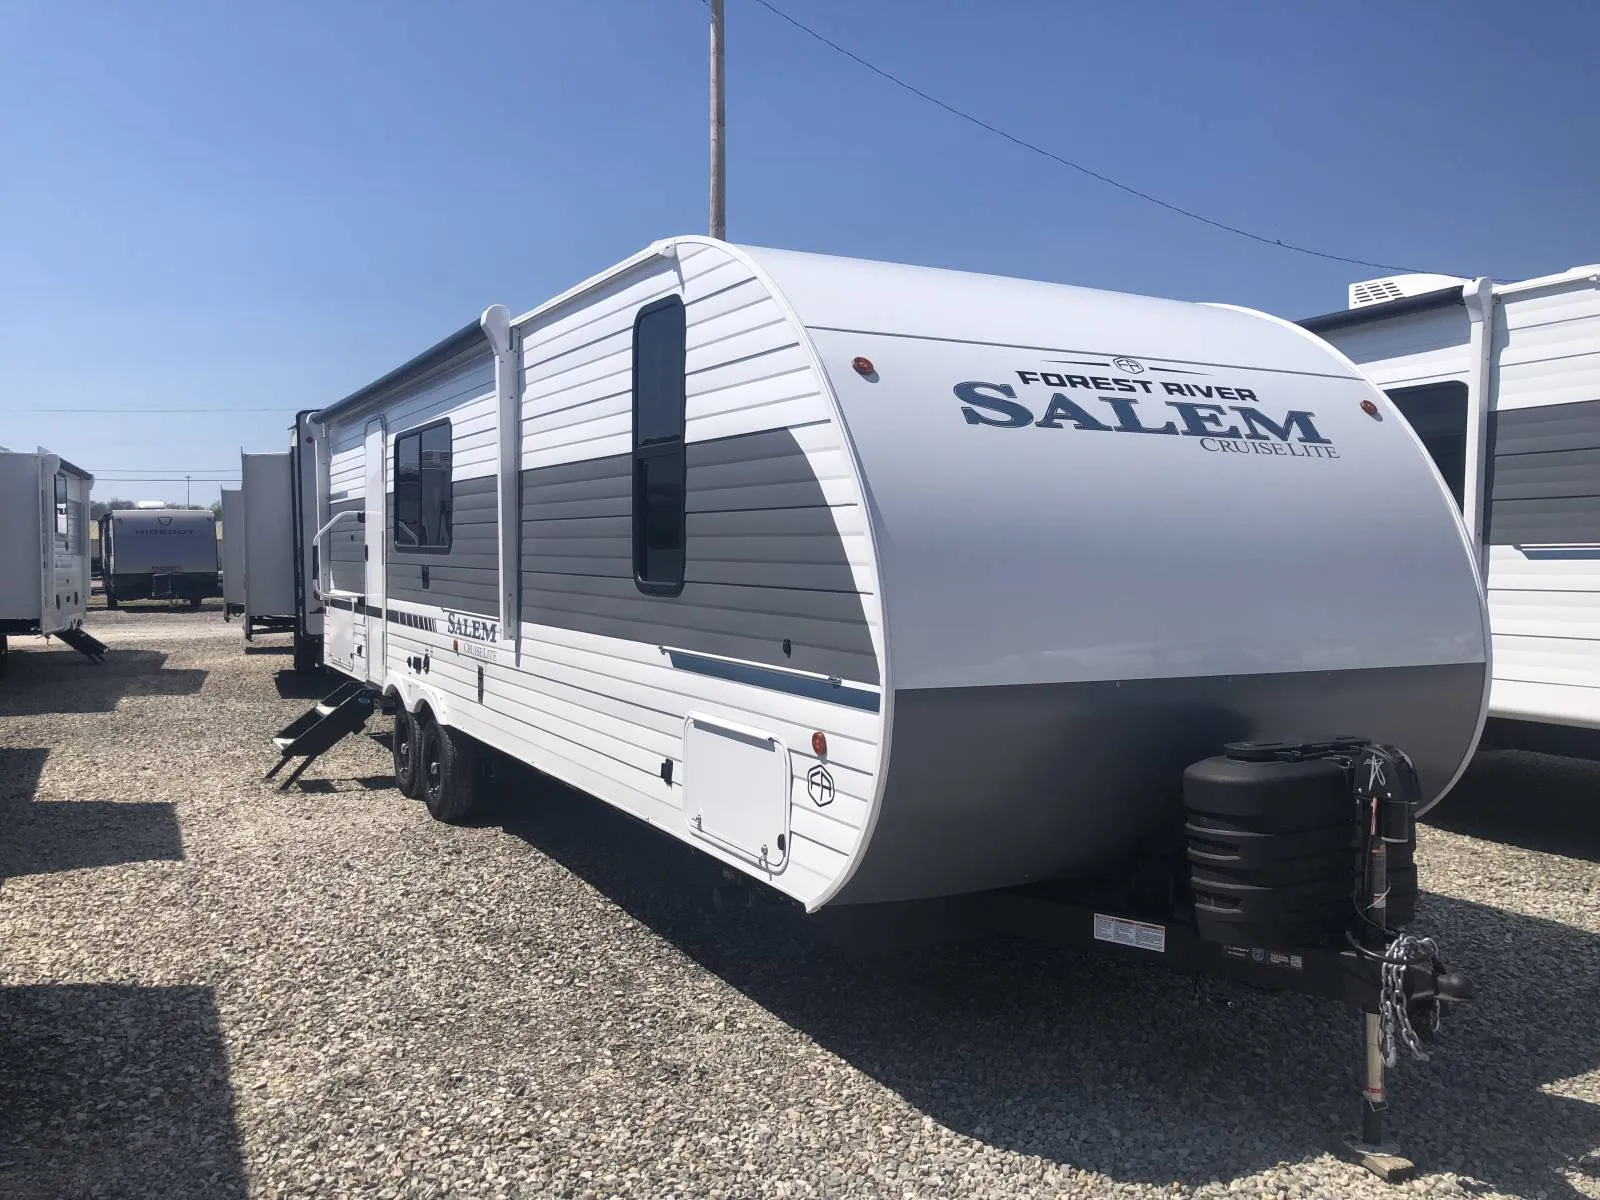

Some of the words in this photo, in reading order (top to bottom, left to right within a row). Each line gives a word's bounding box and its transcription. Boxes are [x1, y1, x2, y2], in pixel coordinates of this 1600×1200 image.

[1015, 370, 1153, 394] FOREST
[1159, 381, 1260, 402] RIVER
[953, 380, 1332, 445] SALEM
[447, 612, 497, 643] SALEM
